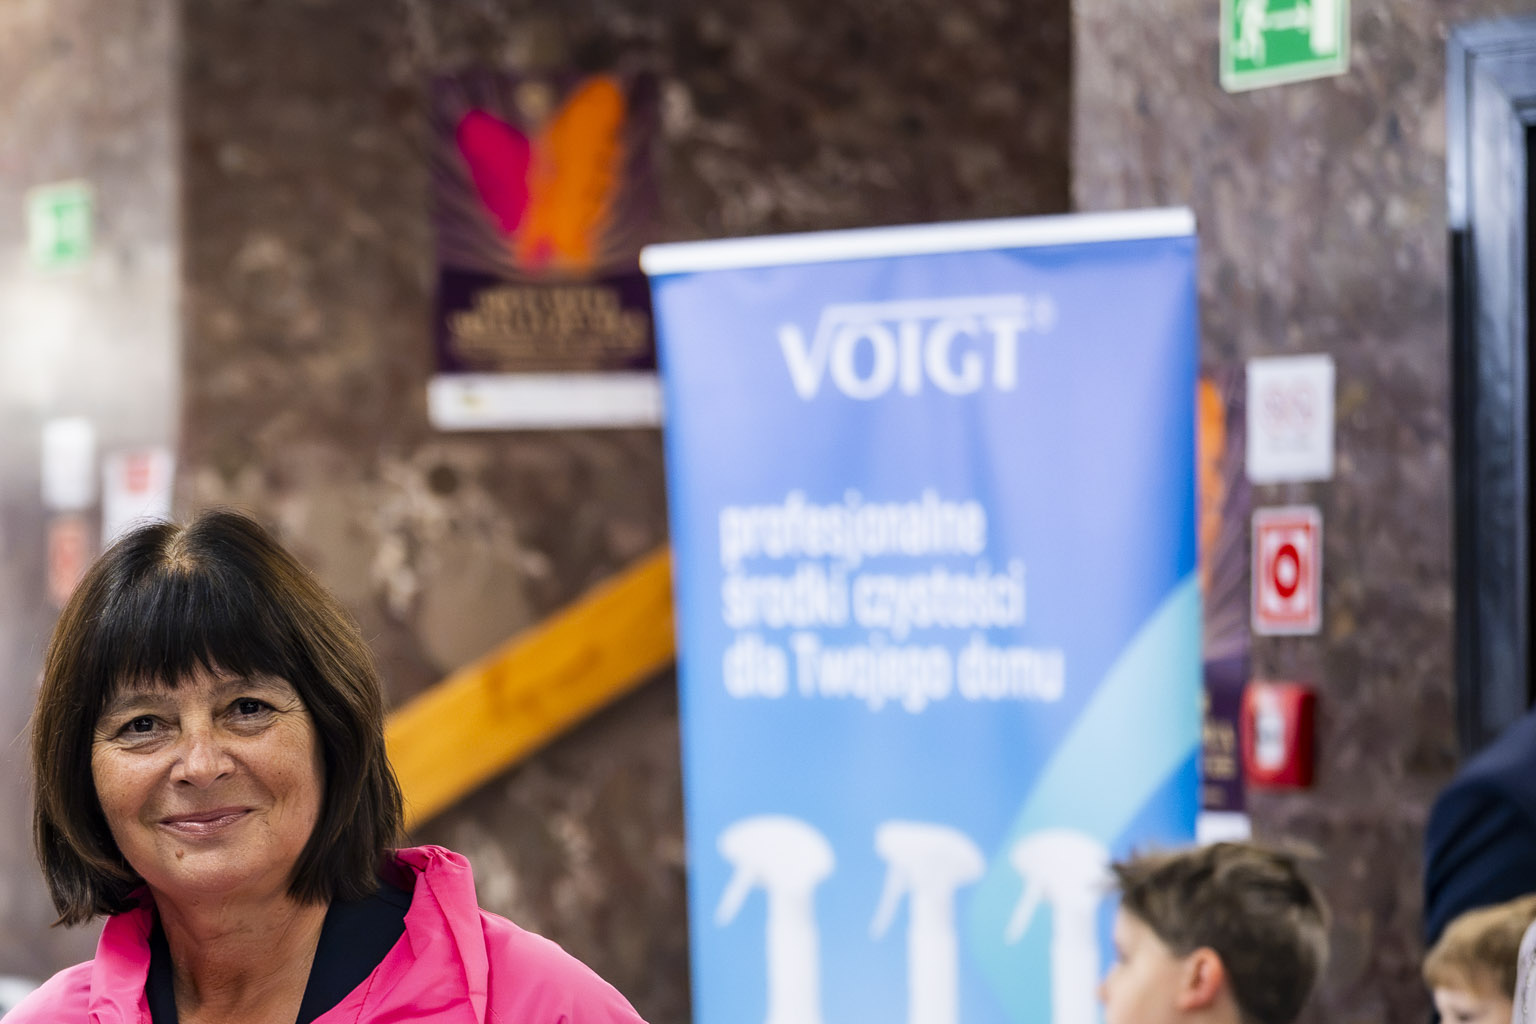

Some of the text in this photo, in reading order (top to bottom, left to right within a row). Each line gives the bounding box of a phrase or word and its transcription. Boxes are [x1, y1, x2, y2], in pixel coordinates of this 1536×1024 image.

[778, 294, 1030, 401] VOIGT
[719, 490, 987, 570] profesjonalne
[720, 558, 1026, 640] środki czystości
[723, 632, 1065, 713] dla Twojego domu
